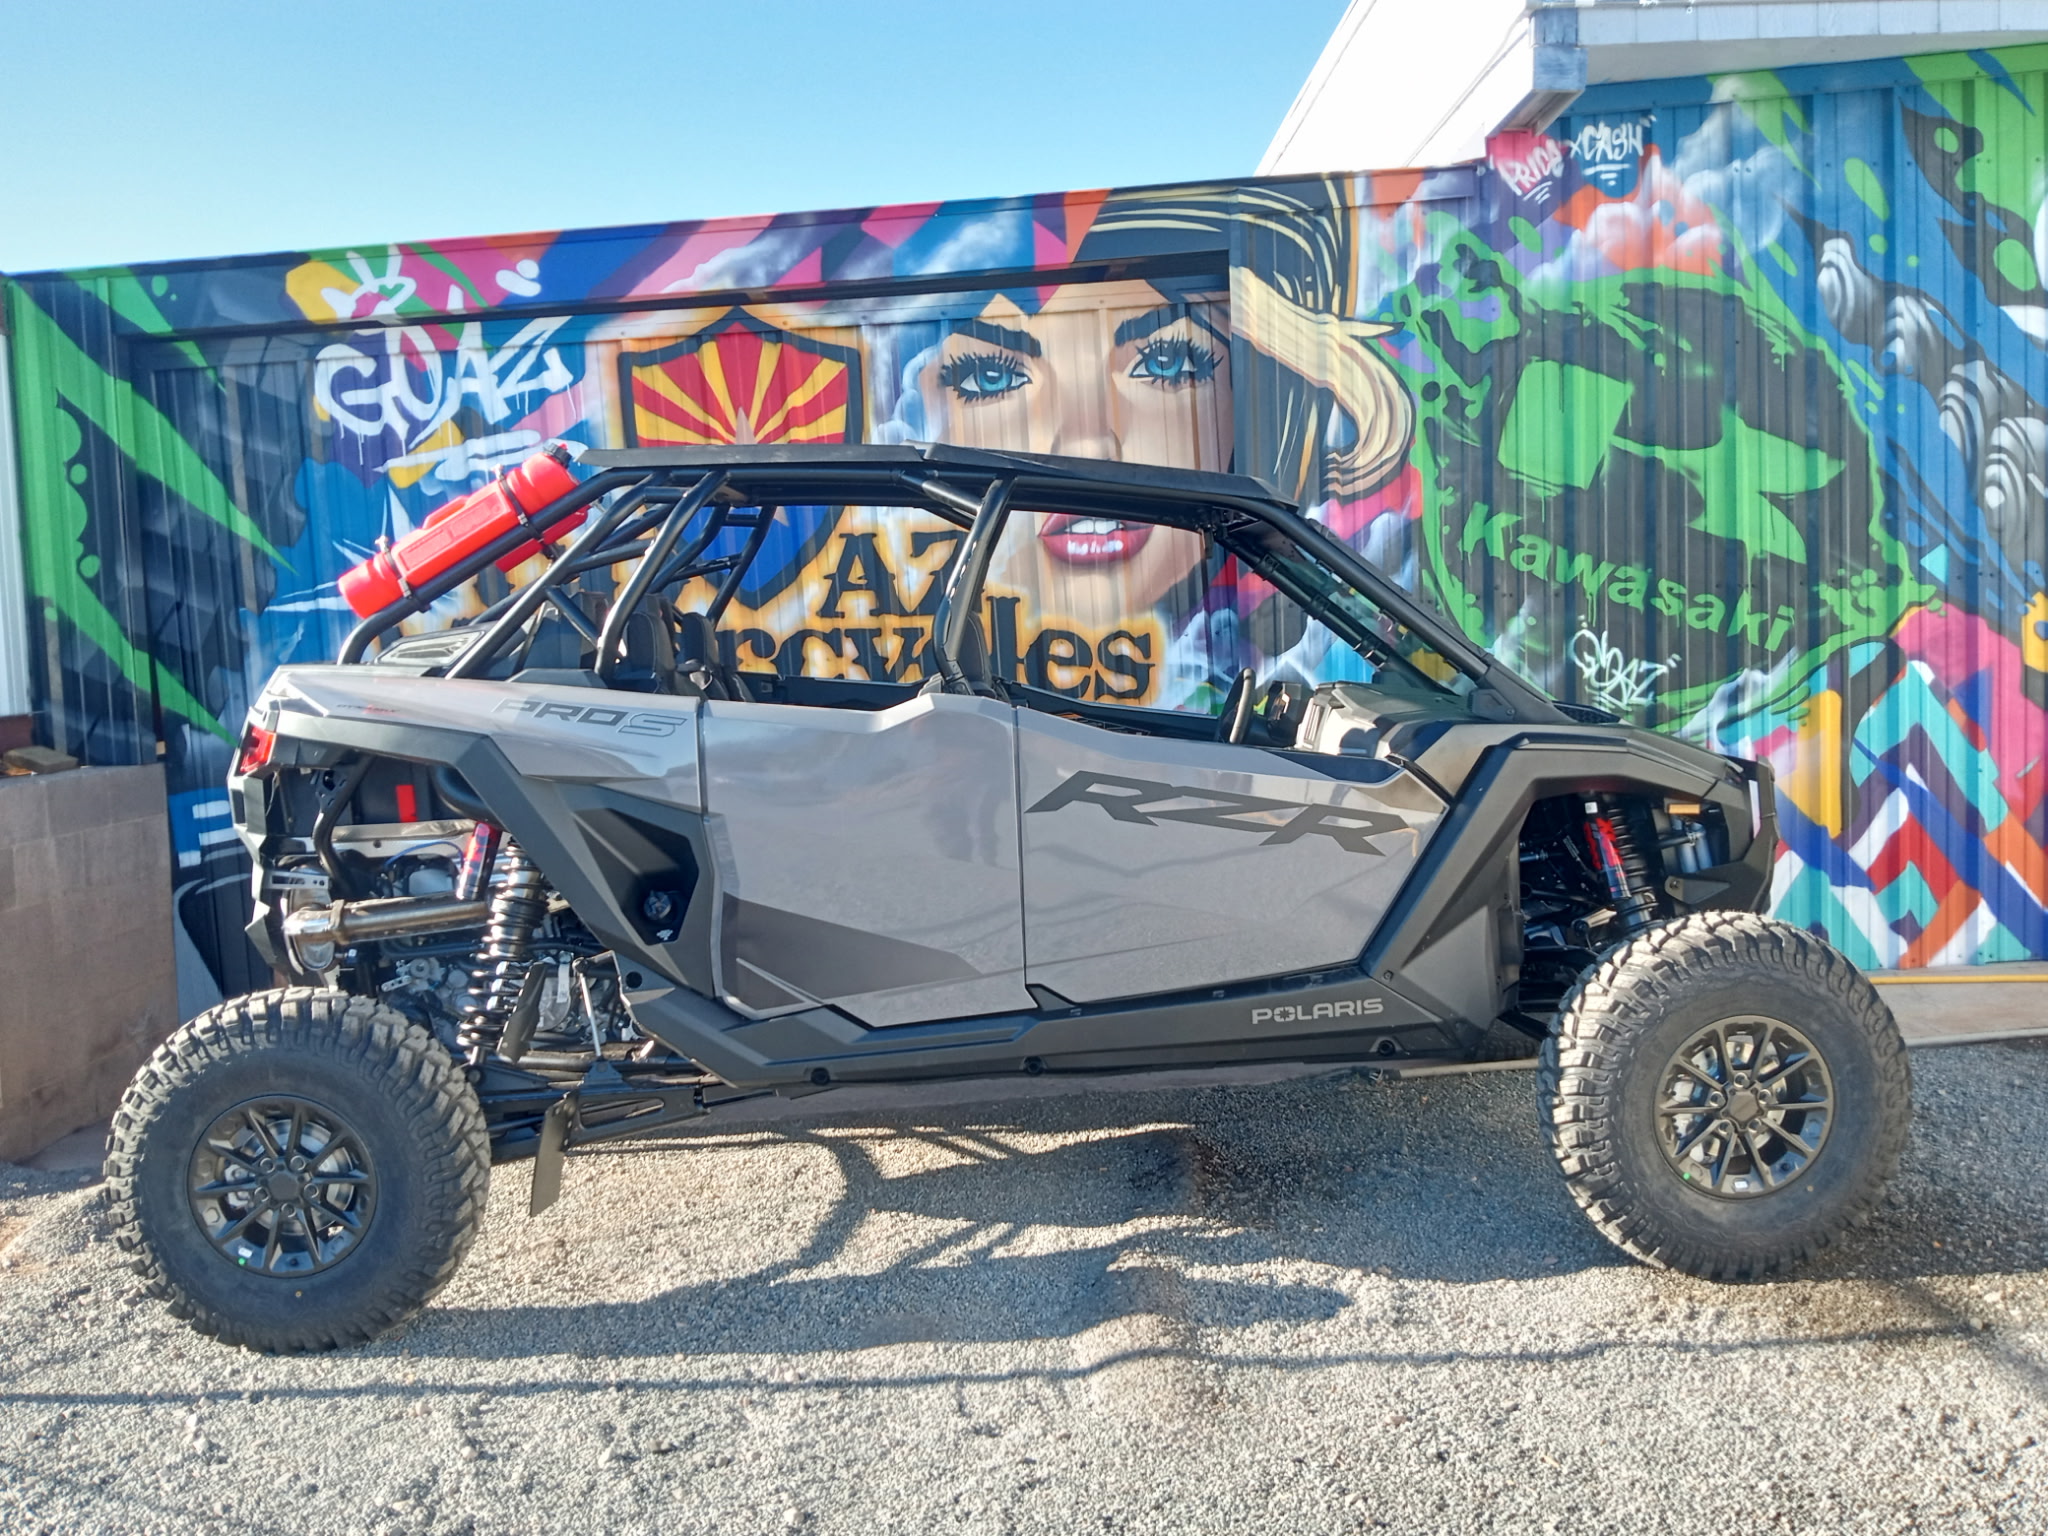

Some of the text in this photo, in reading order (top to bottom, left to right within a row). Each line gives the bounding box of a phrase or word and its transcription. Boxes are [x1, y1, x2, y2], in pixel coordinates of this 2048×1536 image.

[820, 531, 984, 618] AZ
[1460, 501, 1796, 652] Kawasaki
[491, 699, 629, 726] PRO
[1024, 770, 1412, 857] RZR
[1251, 998, 1384, 1025] POLARIS
